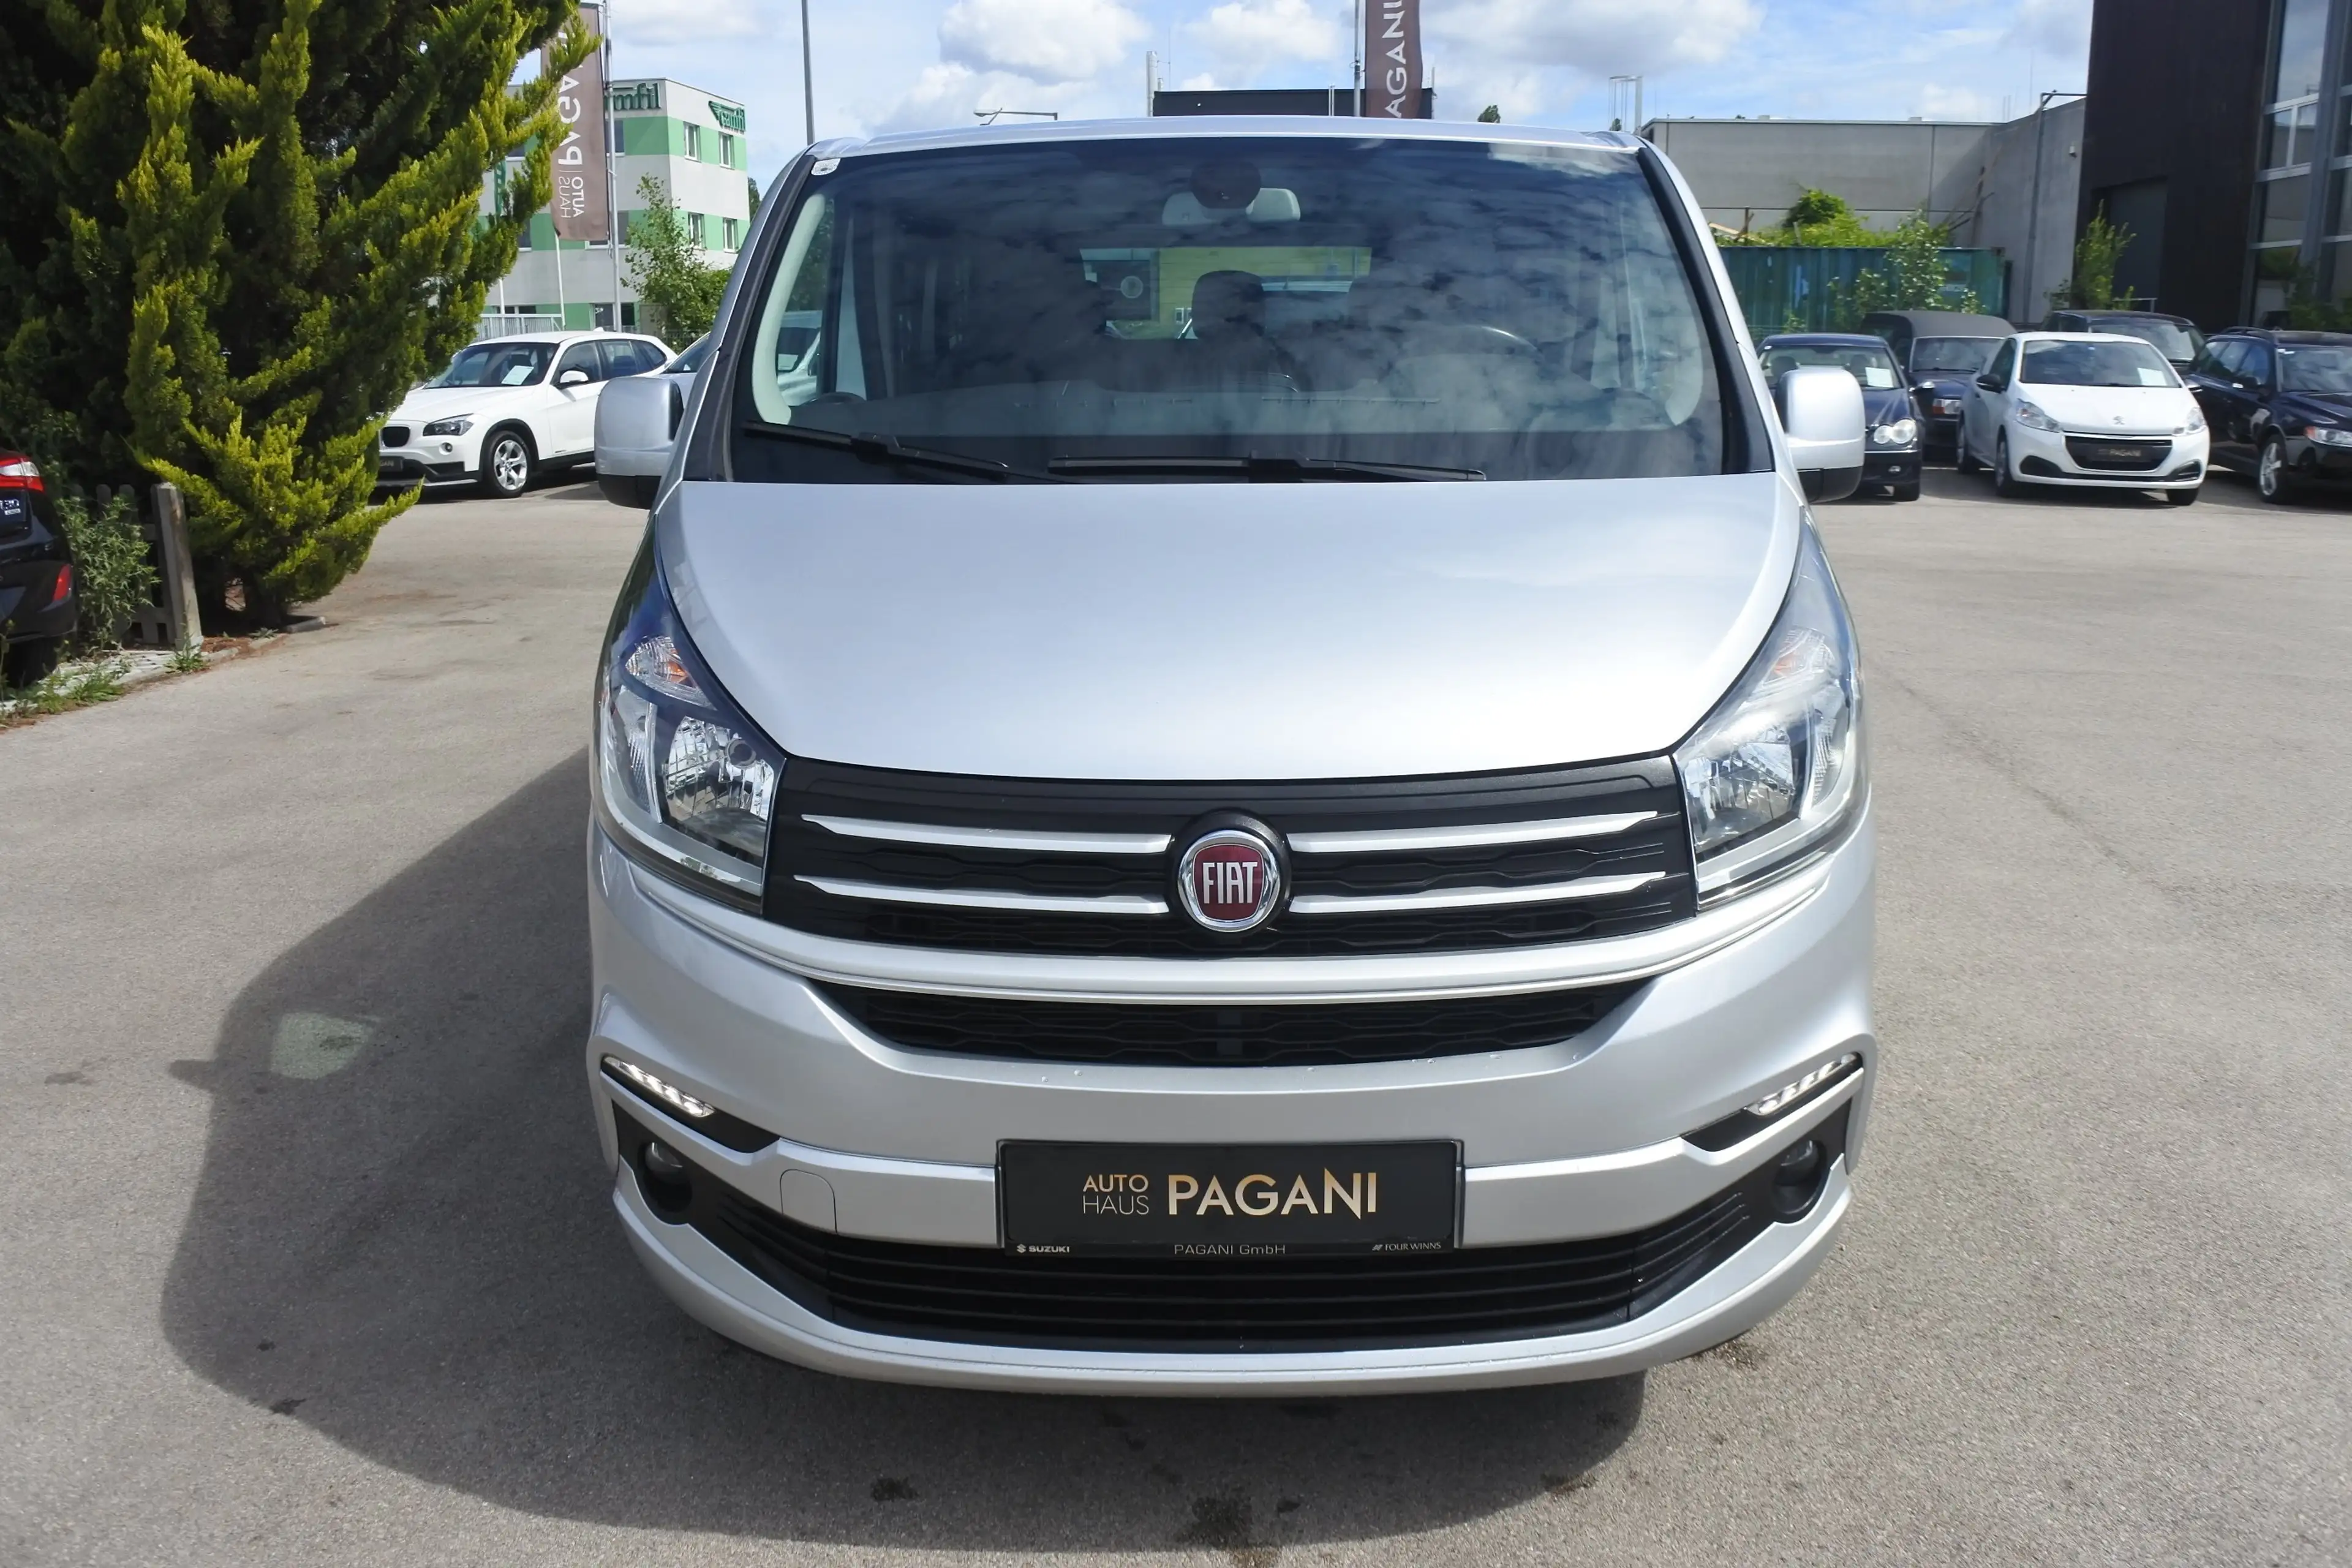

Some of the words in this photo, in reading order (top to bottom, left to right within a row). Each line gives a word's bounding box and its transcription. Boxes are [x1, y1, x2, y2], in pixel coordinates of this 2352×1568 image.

[1202, 862, 1258, 904] FIAT
[1082, 1174, 1149, 1193] AUTO
[1168, 1167, 1377, 1220] PAGANI
[1082, 1195, 1150, 1215] HAUS
[1174, 1244, 1234, 1255] PAGANI
[1239, 1244, 1286, 1255] GmbH
[1410, 1242, 1442, 1250] WINNS
